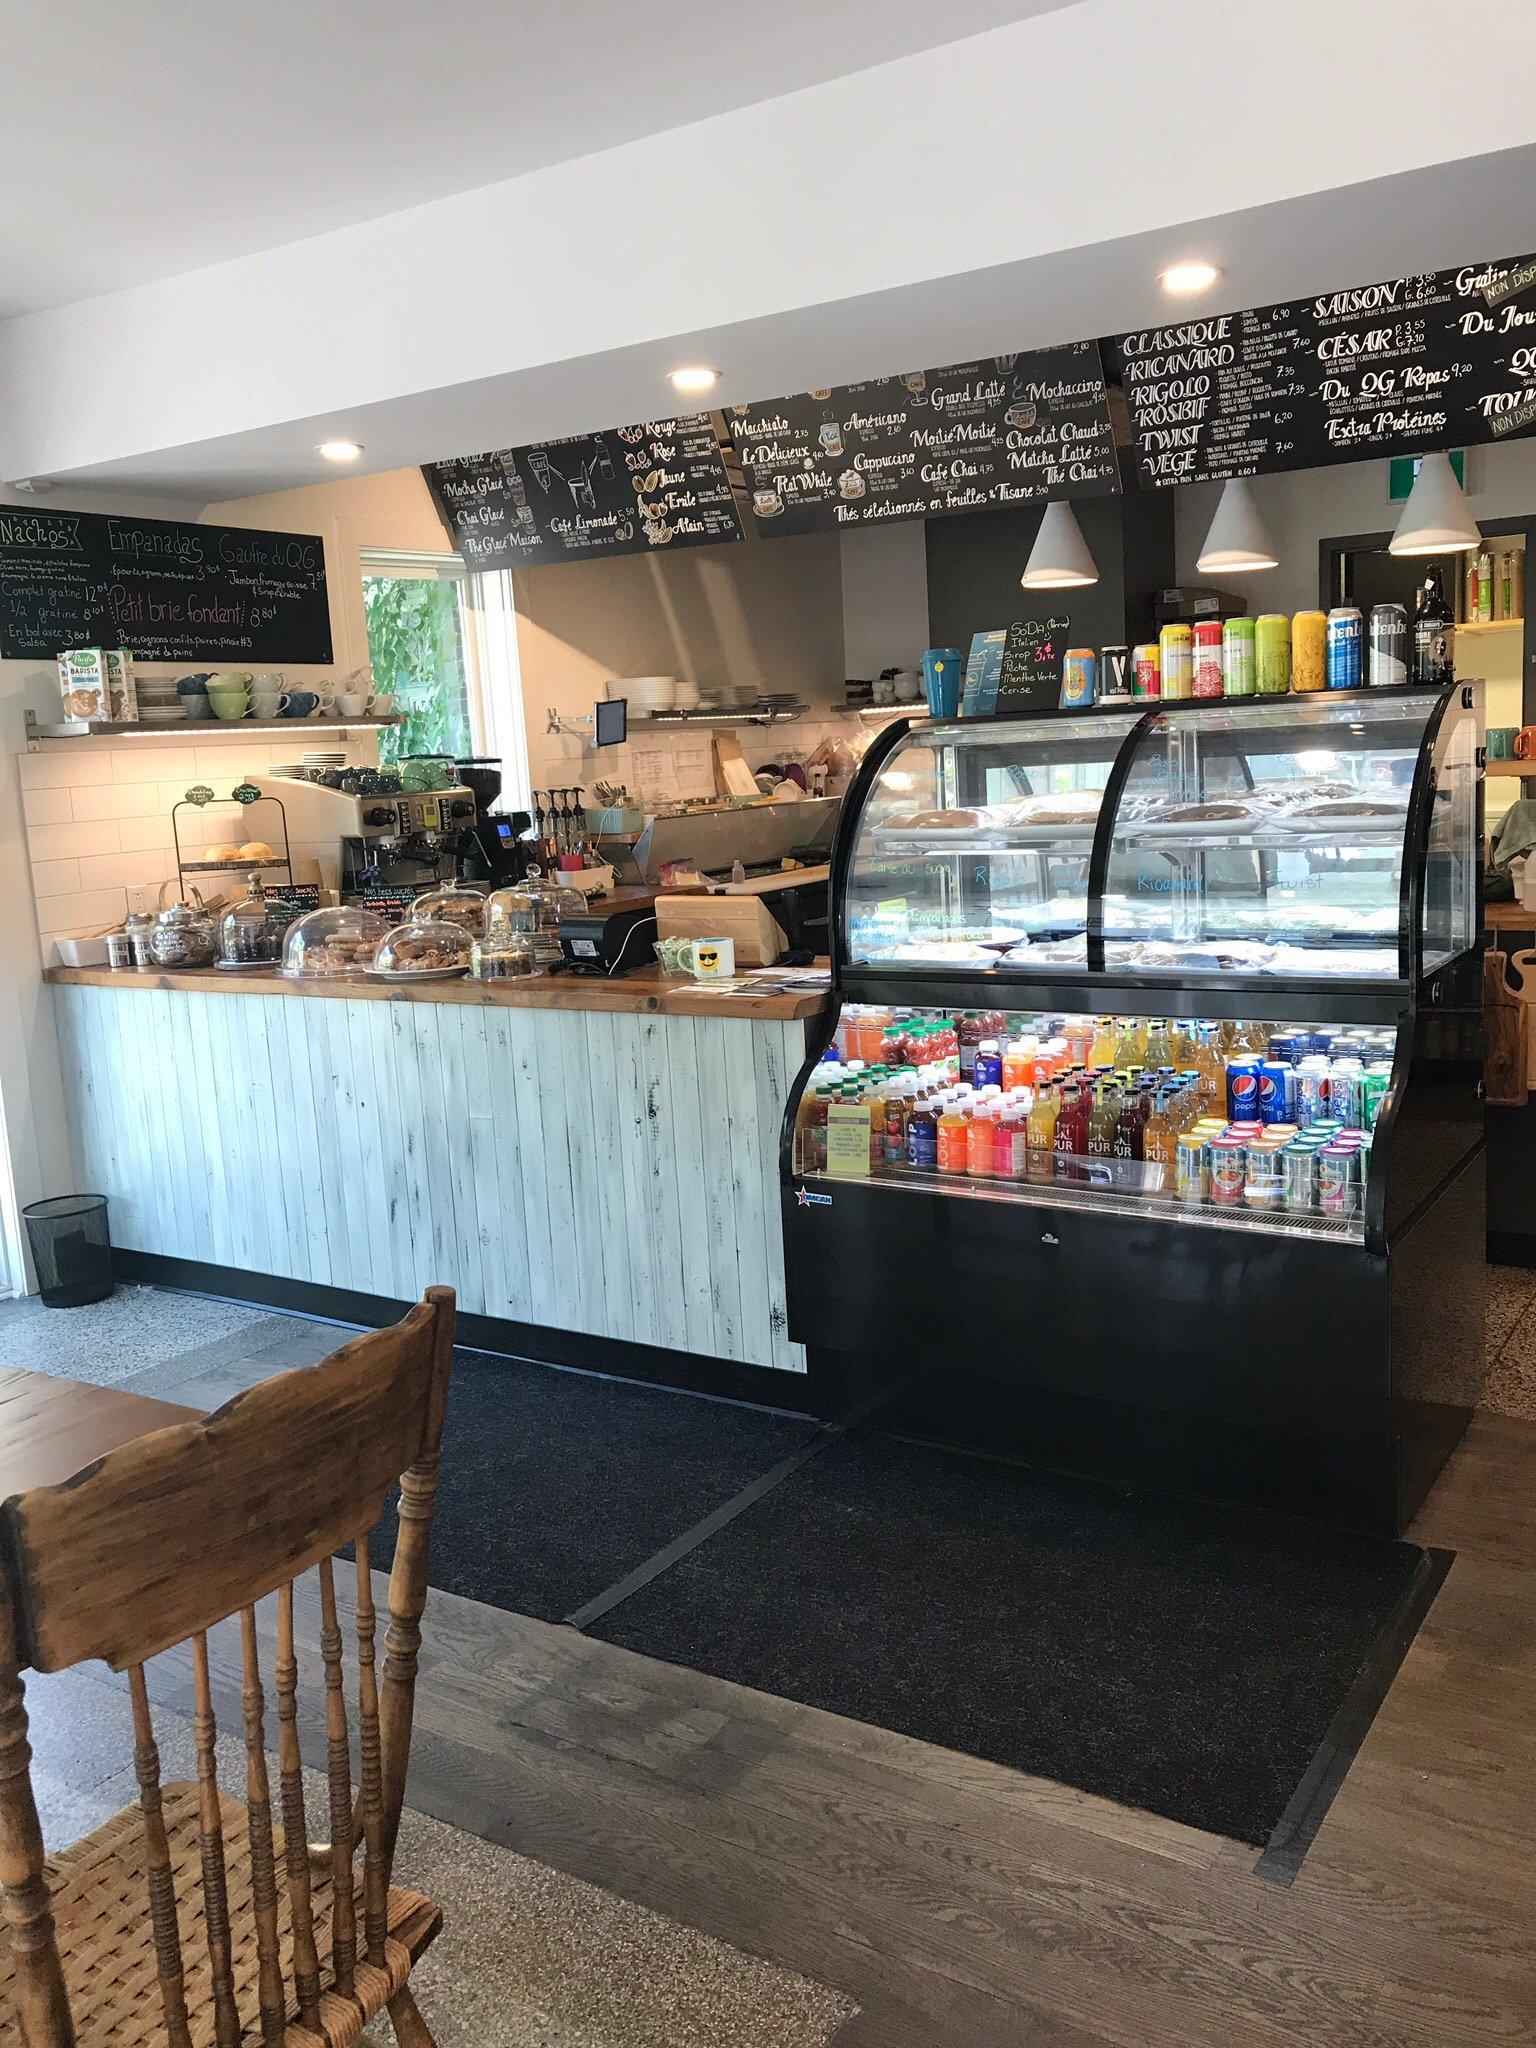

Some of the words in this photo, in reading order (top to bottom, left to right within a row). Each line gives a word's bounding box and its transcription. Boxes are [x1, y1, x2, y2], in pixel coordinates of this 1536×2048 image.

[1313, 280, 1405, 318] SAISON
[1487, 280, 1509, 300] NON
[1459, 311, 1495, 335] Du
[1498, 305, 1536, 334] Jou
[1123, 316, 1233, 356] CLASSIQUE
[1317, 328, 1393, 360] CÉSAR
[1125, 344, 1235, 381] RICANARD
[1026, 380, 1103, 402] Mochaccino
[1131, 375, 1210, 406] RIGOLO
[1319, 380, 1350, 401] Du
[1359, 370, 1396, 398] QG
[1400, 366, 1450, 392] Repas
[1452, 363, 1473, 378] 9,20
[931, 383, 971, 411] Grand
[973, 380, 1006, 401] Latté
[843, 412, 907, 432] Américano
[1135, 396, 1212, 427] ROSBIF
[1492, 414, 1514, 433] NON
[642, 420, 676, 438] Rouge
[731, 414, 789, 438] Macchiato
[1006, 426, 1059, 450] Chocolat
[1060, 420, 1099, 442] Chaud
[1324, 417, 1372, 440] Extra
[1372, 409, 1447, 433] Protéines
[1139, 424, 1205, 451] TWIST
[741, 447, 756, 466] Le
[754, 441, 810, 463] Délicieux
[853, 452, 916, 474] Cappuccino
[1006, 451, 1056, 470] Matcha
[1058, 444, 1093, 464] Latté
[1143, 447, 1198, 476] VÉGÉ
[658, 468, 686, 488] Jaune
[773, 473, 799, 496] Flat
[796, 470, 833, 491] White
[921, 463, 948, 483] Café
[951, 459, 980, 478] Chai
[1042, 466, 1066, 485] Thé
[1069, 462, 1099, 482] Chai
[1194, 473, 1209, 481] SANS
[1211, 470, 1233, 479] GLUTEN
[477, 476, 504, 497] Glacé
[833, 503, 860, 522] Thés
[863, 498, 927, 518] sélectionnés
[929, 498, 943, 510] en
[946, 488, 988, 508] feuilles
[989, 488, 997, 499] &
[995, 482, 1034, 501] Tisane
[456, 510, 479, 525] Chai
[480, 506, 505, 526] Glacé
[550, 517, 572, 533] Café
[575, 511, 618, 530] Limonade
[672, 517, 705, 534] Alain
[0, 518, 69, 548] Nachos
[107, 520, 204, 564] Empanadas
[465, 538, 483, 554] Thé
[507, 532, 543, 548] Maison
[220, 533, 268, 565] Gaufre
[286, 543, 315, 570] QG
[1, 582, 44, 601] Complet
[47, 585, 83, 607] gratiné
[109, 585, 143, 622] Petit
[148, 593, 185, 623] brie
[187, 594, 241, 625] fondant
[10, 599, 28, 617] 1/2
[38, 607, 79, 624] gratiné
[8, 623, 23, 637] En
[25, 622, 40, 637] bol
[42, 629, 63, 637] avec
[1011, 637, 1039, 648] Italien
[1004, 650, 1031, 662] Sirop
[70, 667, 99, 675] BARISTA
[1003, 673, 1036, 684] Menthe
[1037, 671, 1059, 681] Verte
[1001, 685, 1033, 695] Cerise
[1027, 1133, 1047, 1144] PUR
[1054, 1139, 1073, 1151] PUR
[1088, 1141, 1111, 1153] PUR
[1146, 1149, 1169, 1161] PUR
